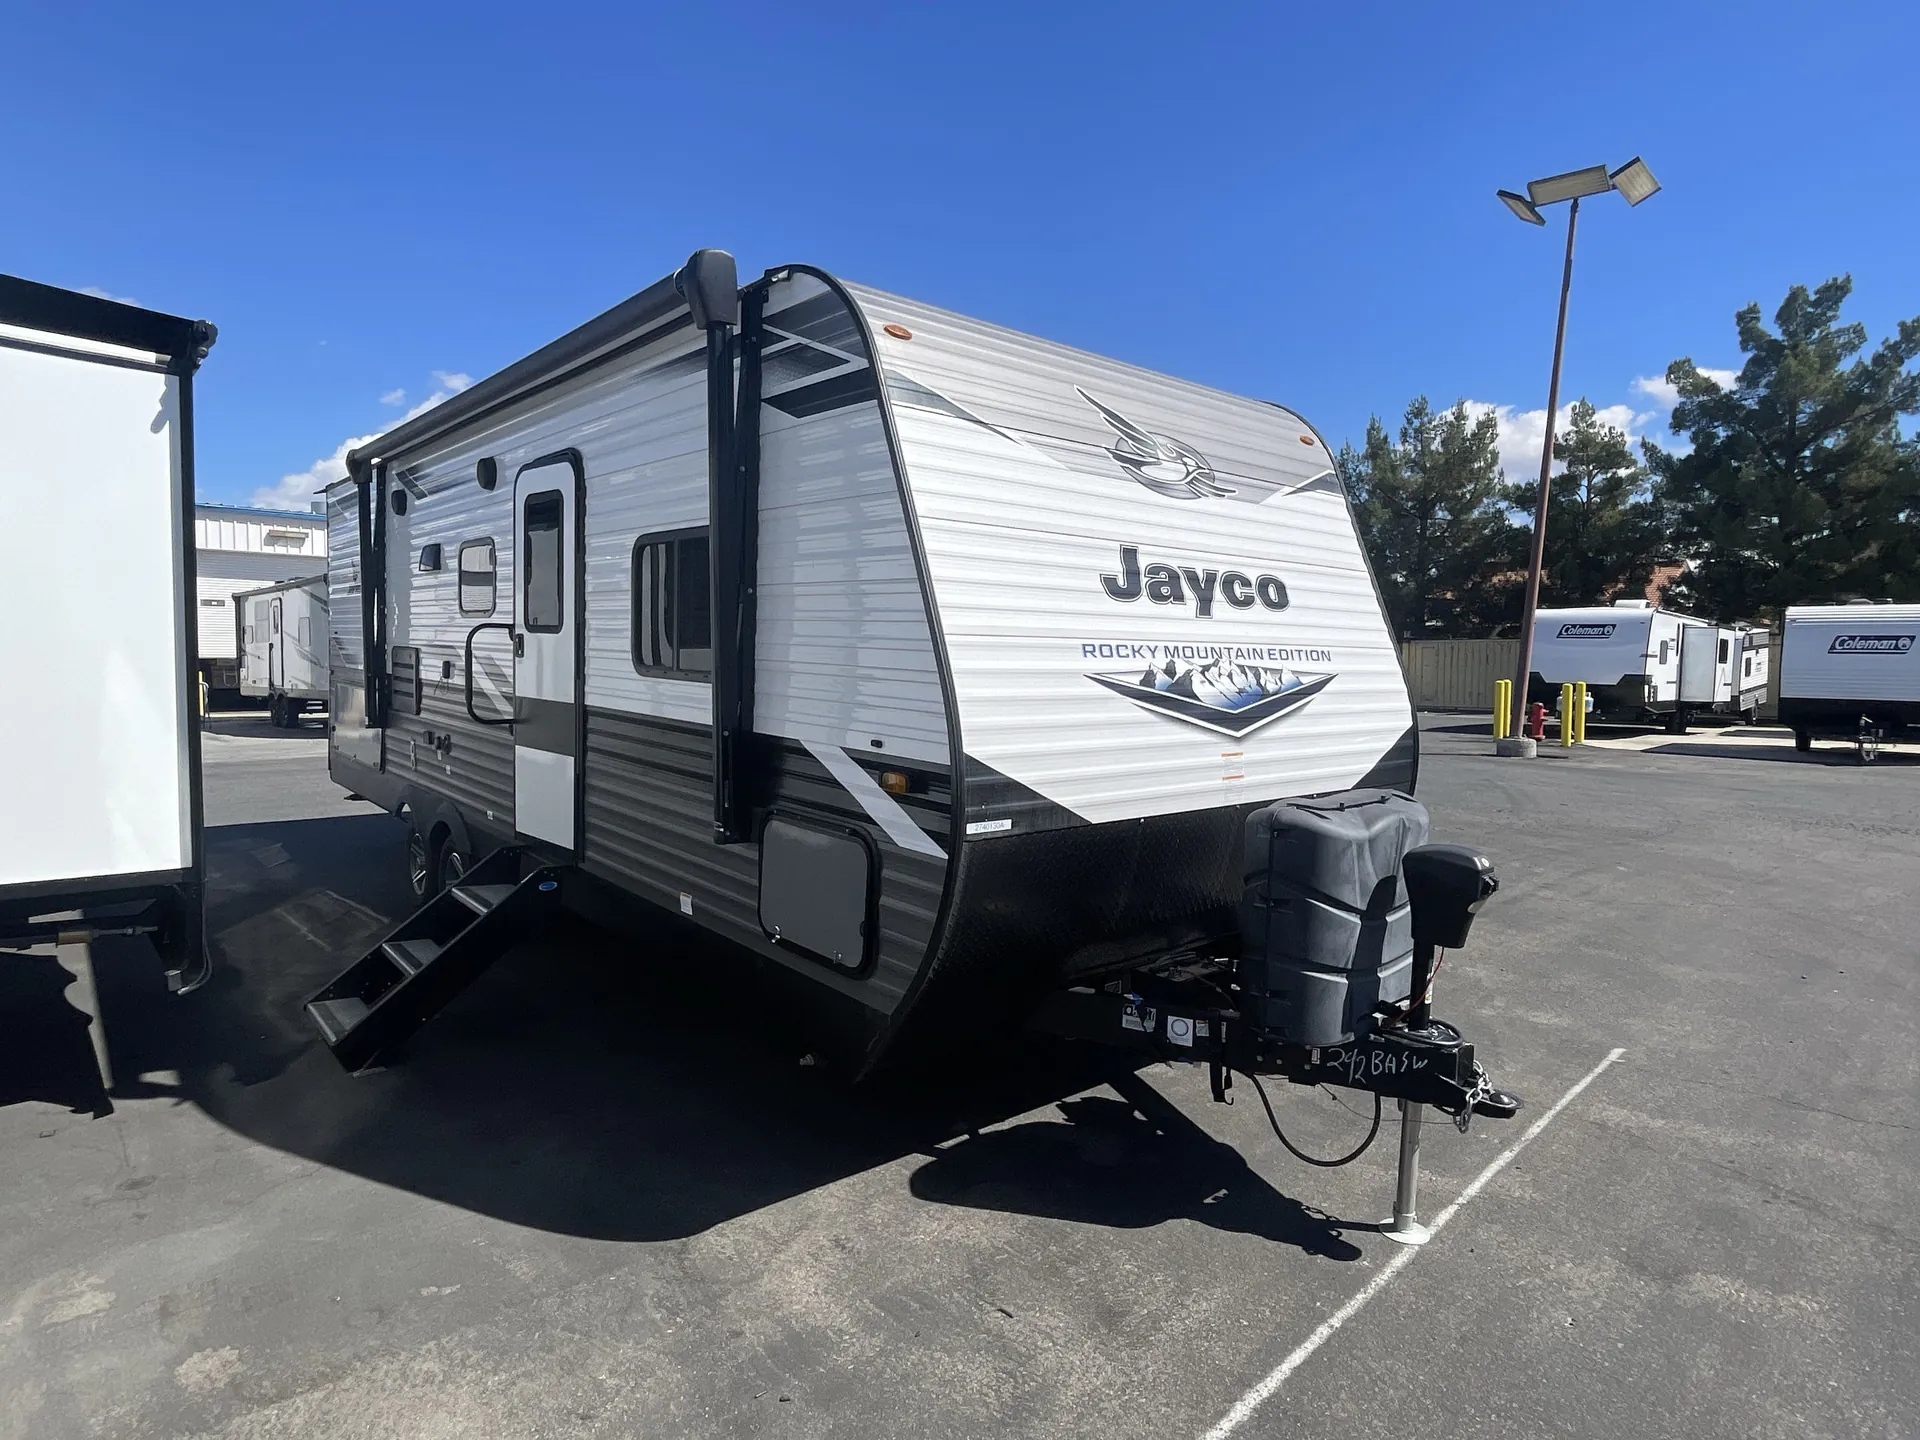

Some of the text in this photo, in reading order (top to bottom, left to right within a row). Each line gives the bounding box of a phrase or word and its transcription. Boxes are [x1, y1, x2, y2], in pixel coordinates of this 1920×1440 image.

[1100, 544, 1290, 618] Jayco
[1561, 624, 1604, 635] Coleman
[1835, 636, 1897, 650] Coleman
[1081, 643, 1331, 662] ROCKY MOUNTAIN EDITION
